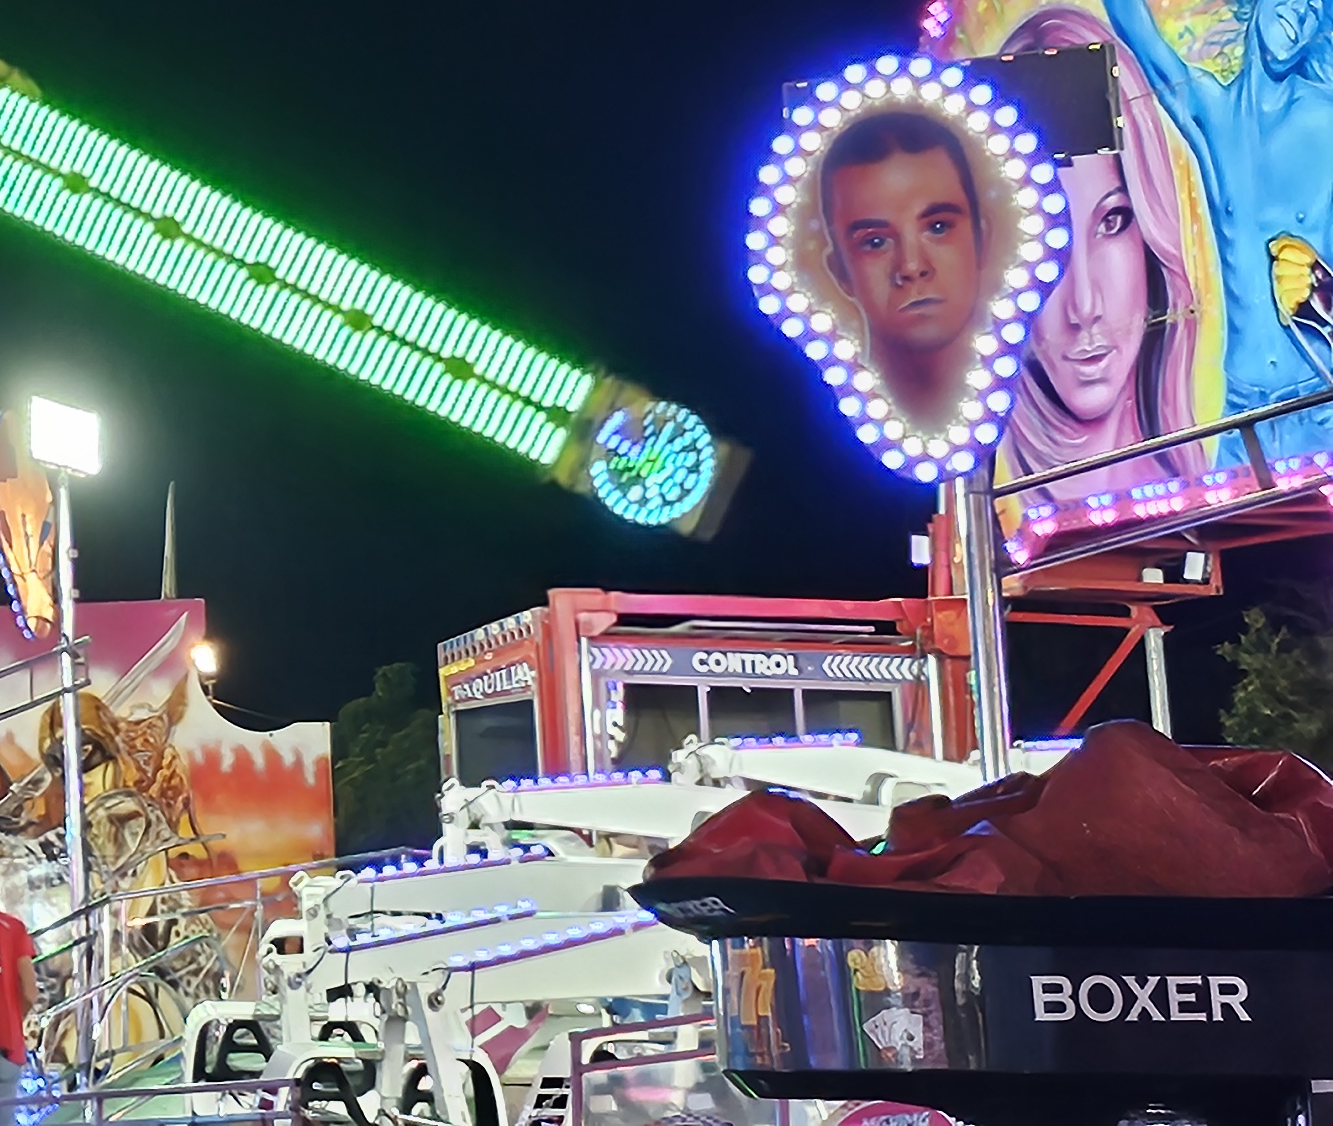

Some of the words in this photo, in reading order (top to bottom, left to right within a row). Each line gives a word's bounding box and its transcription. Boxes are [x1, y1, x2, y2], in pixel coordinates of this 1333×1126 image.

[450, 662, 537, 701] TAQUILLA
[692, 651, 799, 676] CONTROL
[1029, 974, 1252, 1022] BOXER
